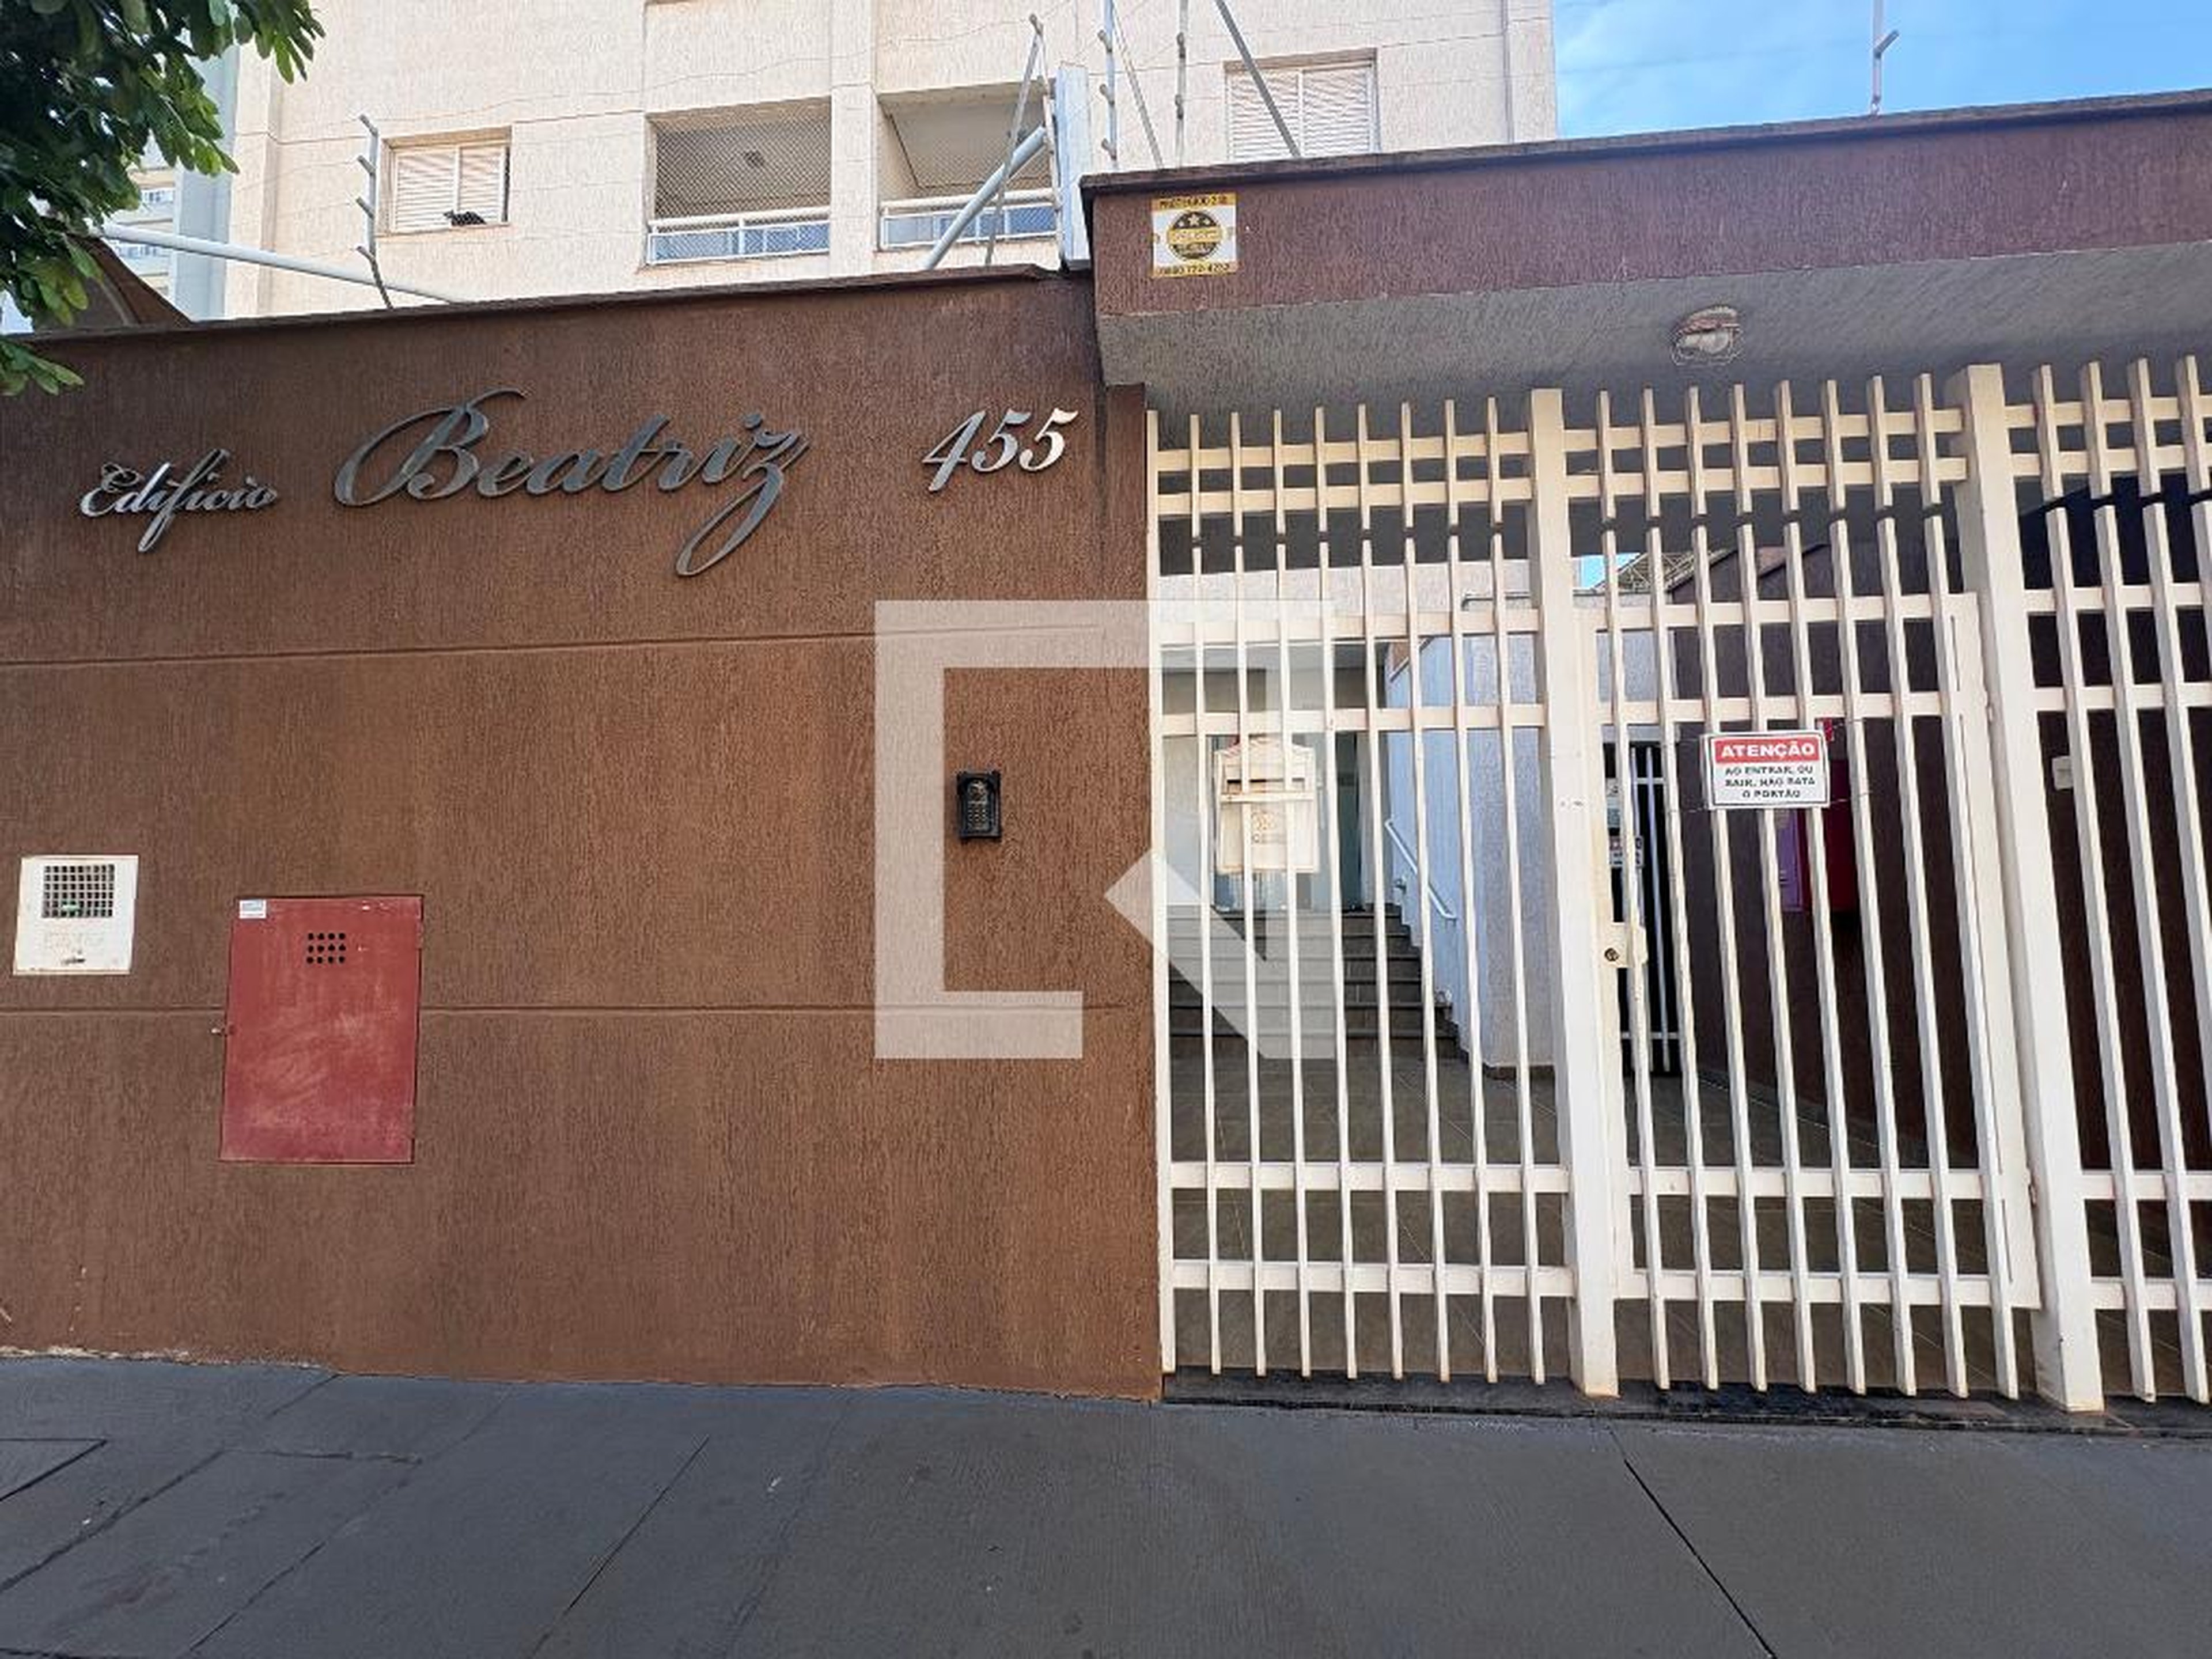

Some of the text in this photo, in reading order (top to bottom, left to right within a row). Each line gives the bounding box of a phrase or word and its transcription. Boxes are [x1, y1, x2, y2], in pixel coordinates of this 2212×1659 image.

[334, 388, 809, 577] Beatriz
[922, 407, 1079, 491] 455
[1721, 741, 1815, 758] ATENÇÃO
[1725, 767, 1742, 776] AO
[1797, 764, 1814, 774] OU
[1787, 776, 1816, 785] BATA
[1742, 788, 1801, 798] O PORTÃO
